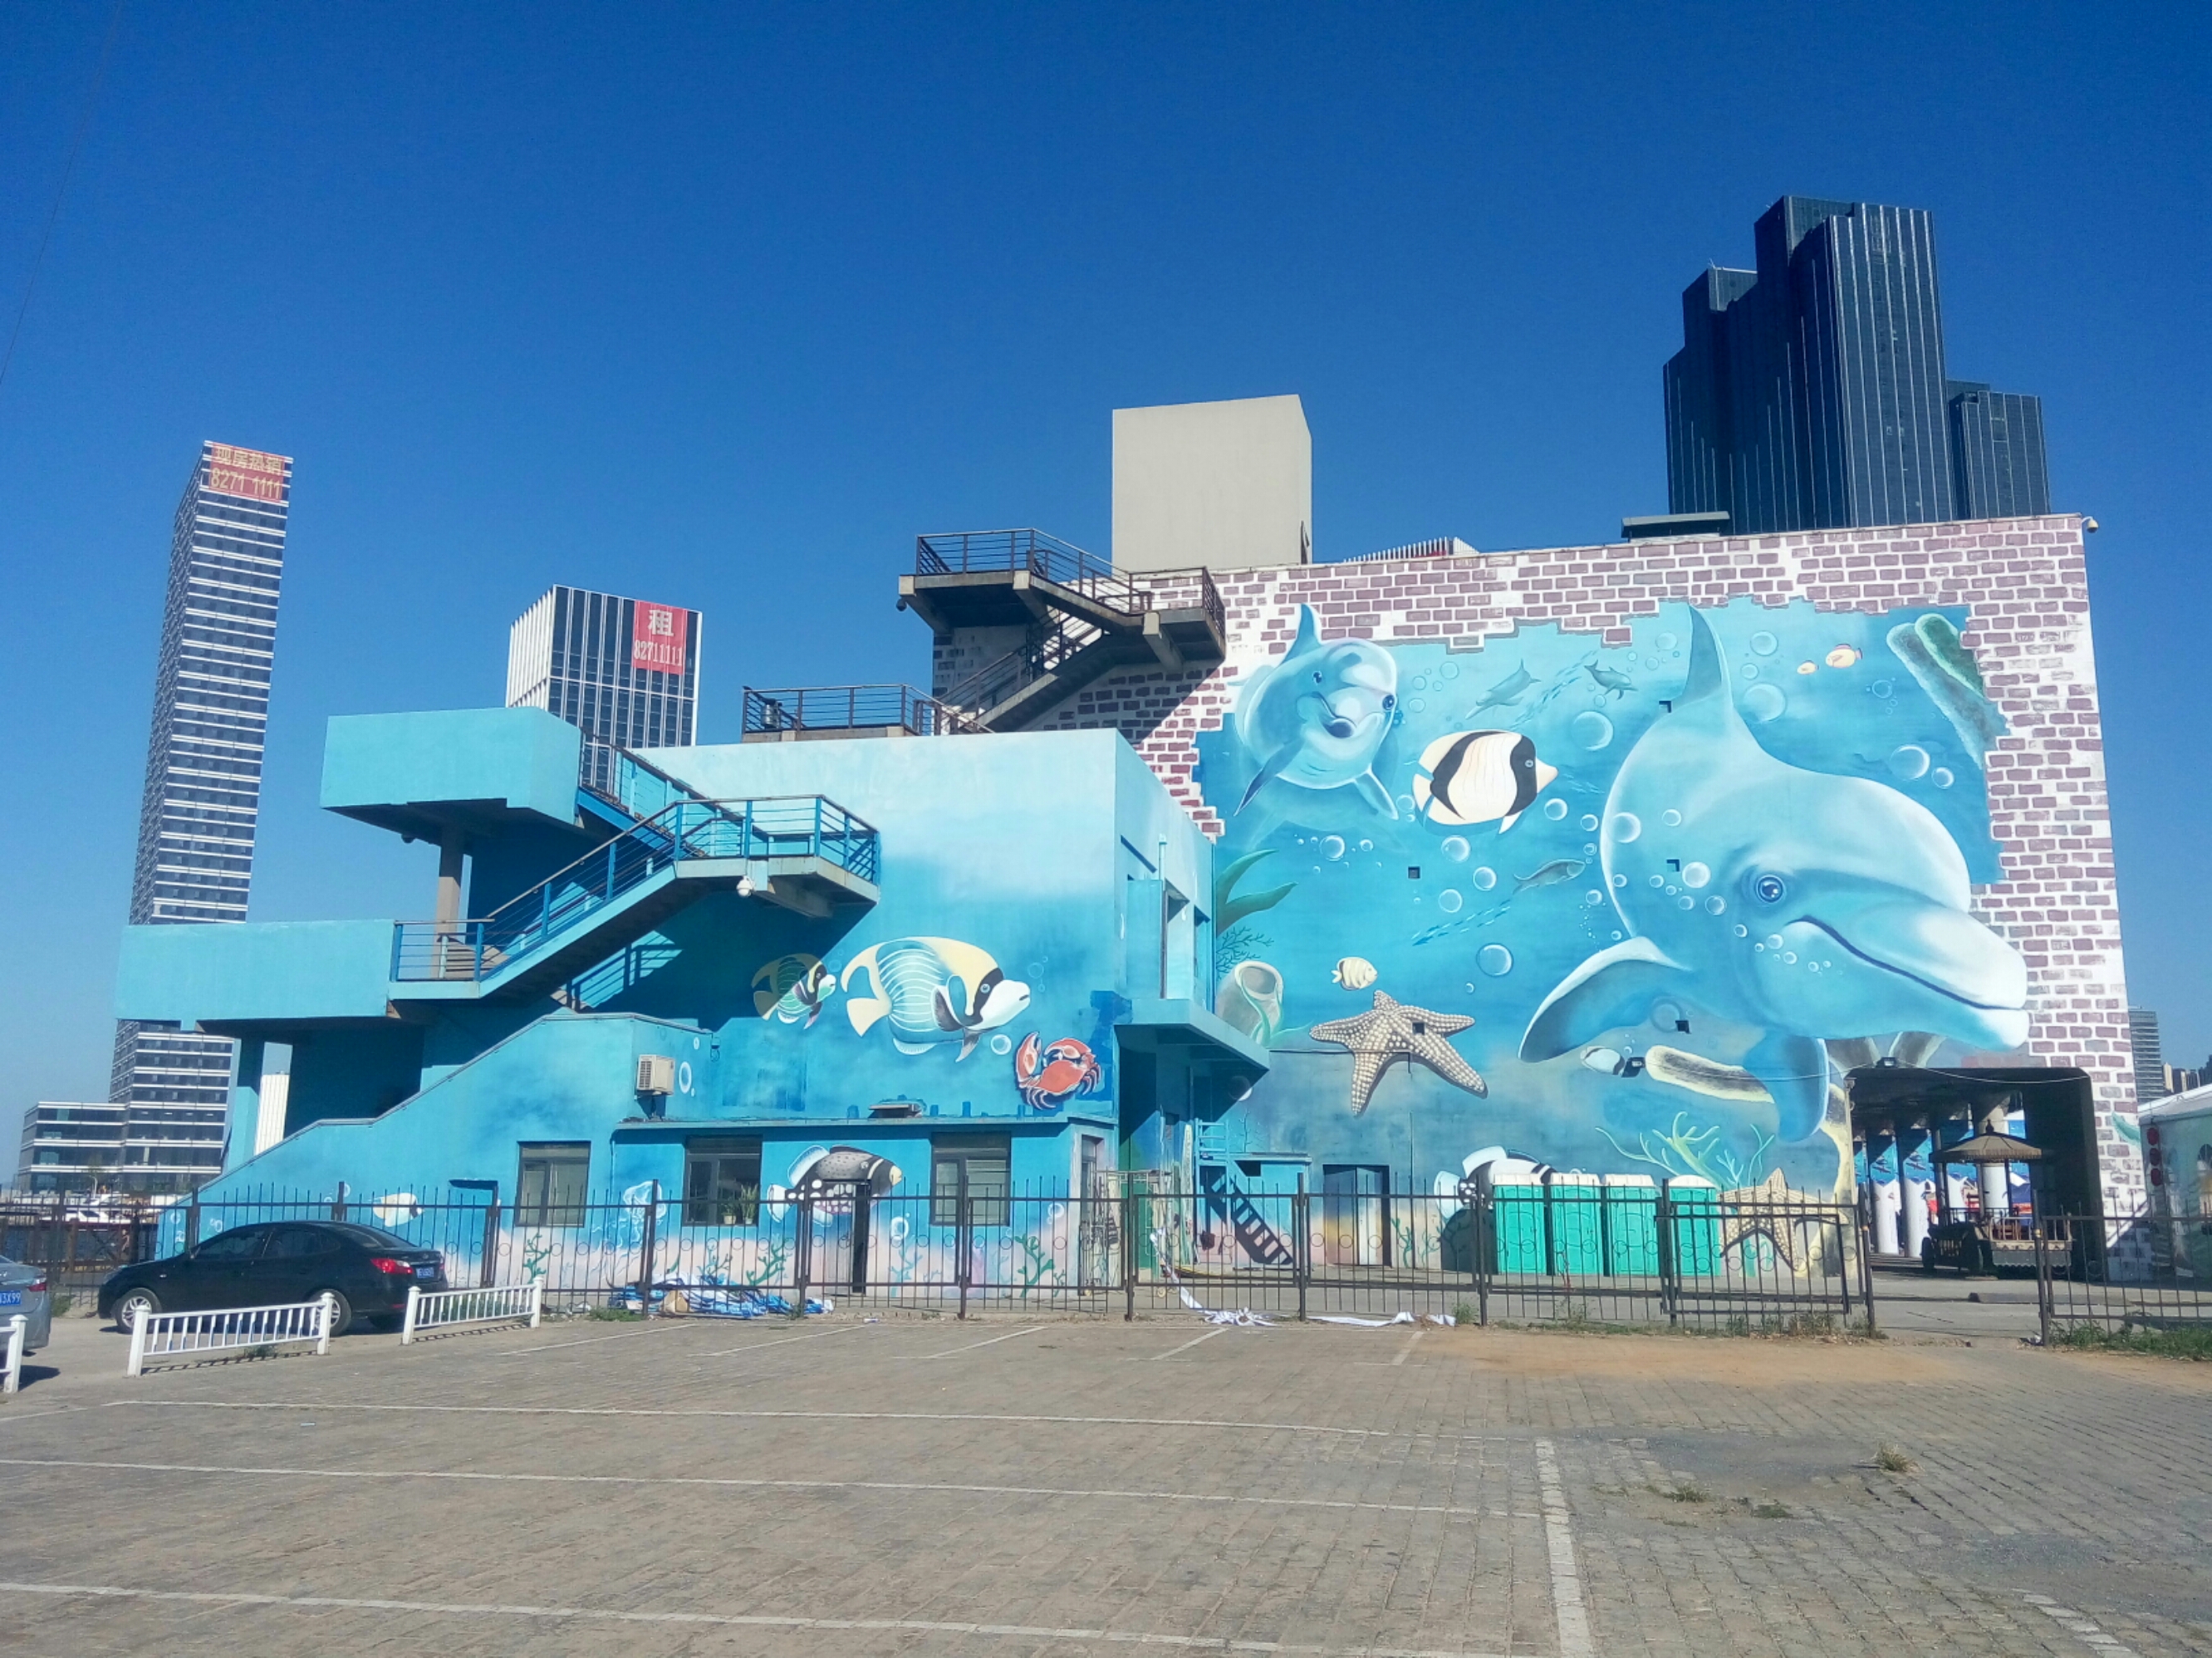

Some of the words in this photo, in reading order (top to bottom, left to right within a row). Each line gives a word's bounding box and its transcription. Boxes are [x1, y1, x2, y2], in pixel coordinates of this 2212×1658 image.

[211, 467, 245, 493] 8271
[253, 475, 281, 499] 1111
[647, 609, 674, 637] 租
[634, 639, 683, 666] 82711111
